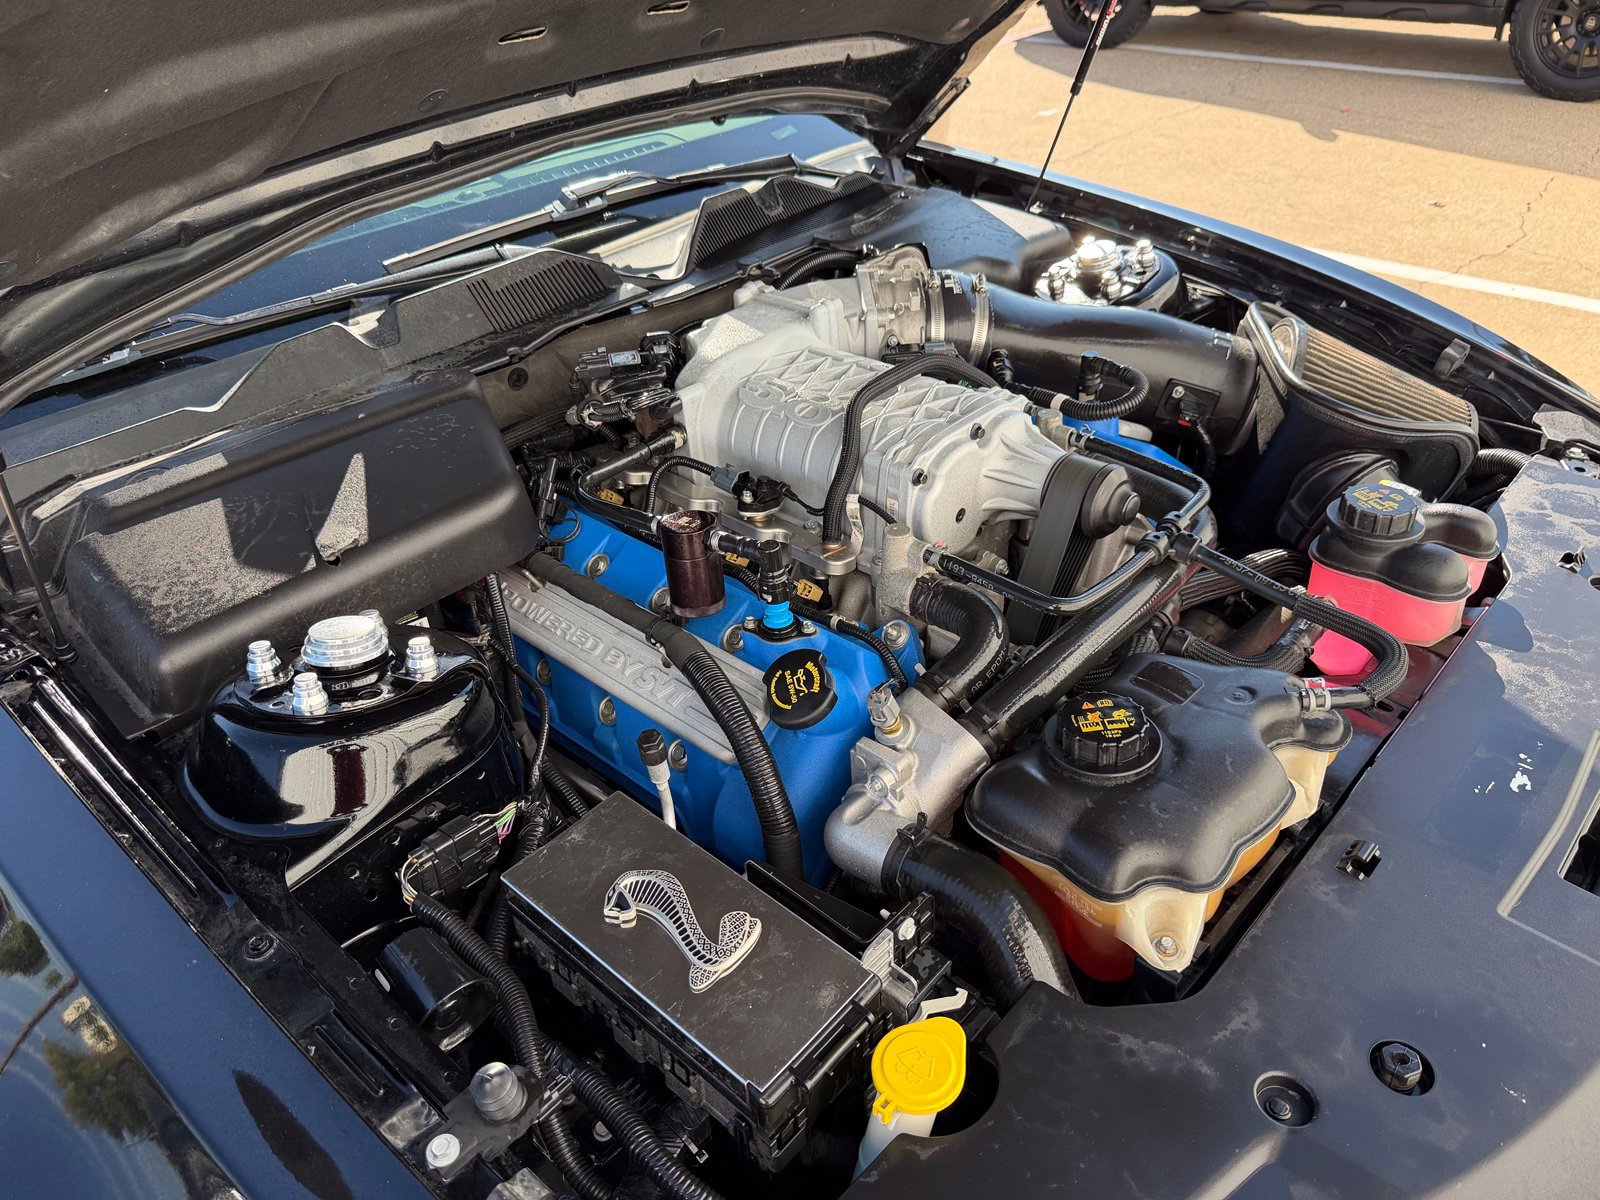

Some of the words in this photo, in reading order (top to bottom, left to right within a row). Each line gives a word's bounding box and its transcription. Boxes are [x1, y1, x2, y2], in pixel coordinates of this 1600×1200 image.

[602, 647, 644, 677] BY
[634, 665, 695, 708] SVT
[785, 670, 793, 684] SAE
[805, 661, 821, 693] Motorcraft
